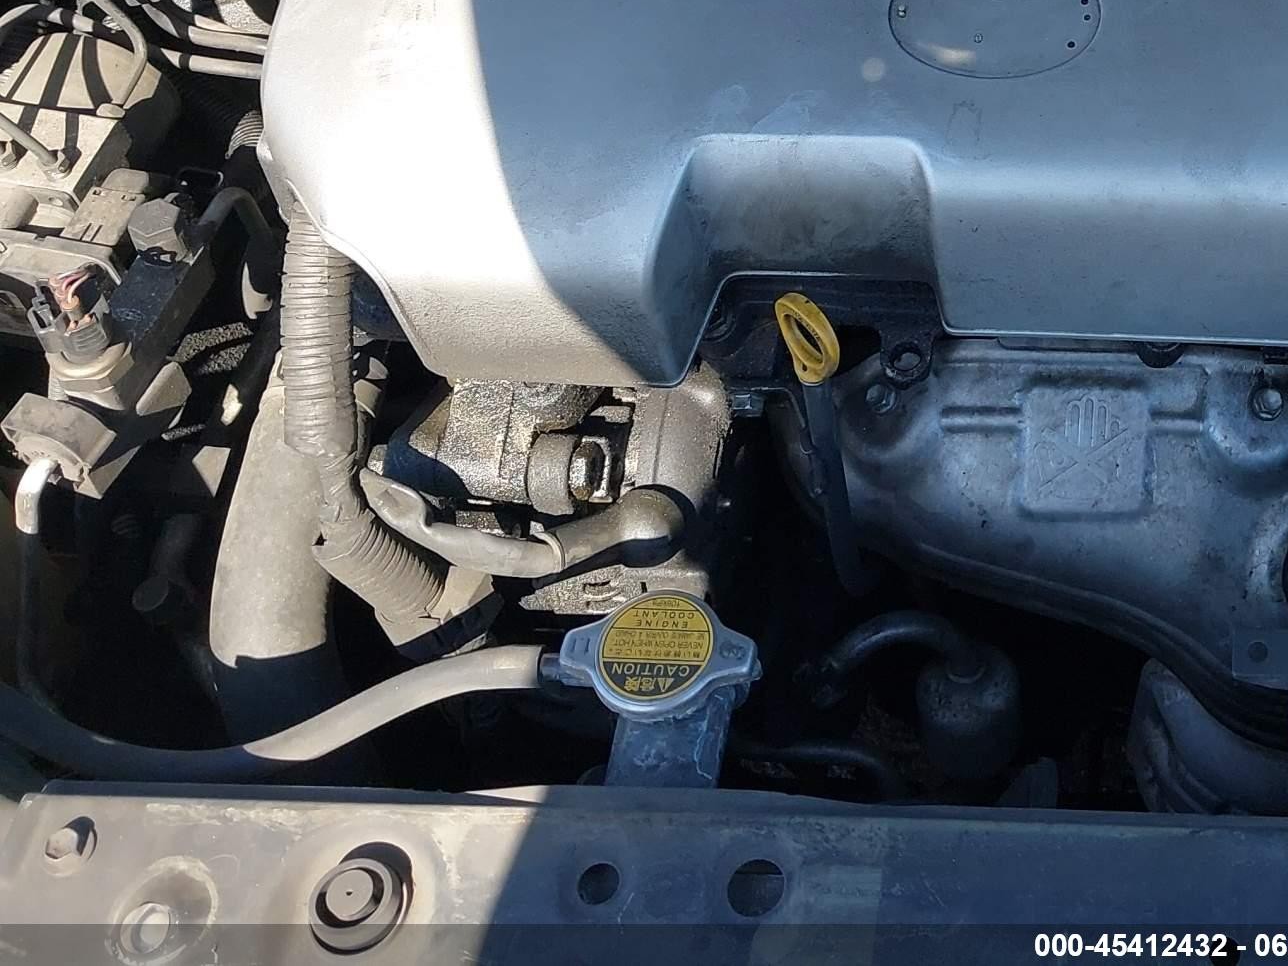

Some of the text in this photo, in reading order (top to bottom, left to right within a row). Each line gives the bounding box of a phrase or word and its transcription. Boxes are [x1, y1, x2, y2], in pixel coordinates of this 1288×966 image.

[633, 610, 695, 619] COOLANT
[636, 619, 689, 629] ENGINE
[630, 639, 653, 648] WHEN
[655, 640, 676, 648] OPEN
[678, 640, 704, 649] NEVER
[611, 662, 690, 677] CAUTION
